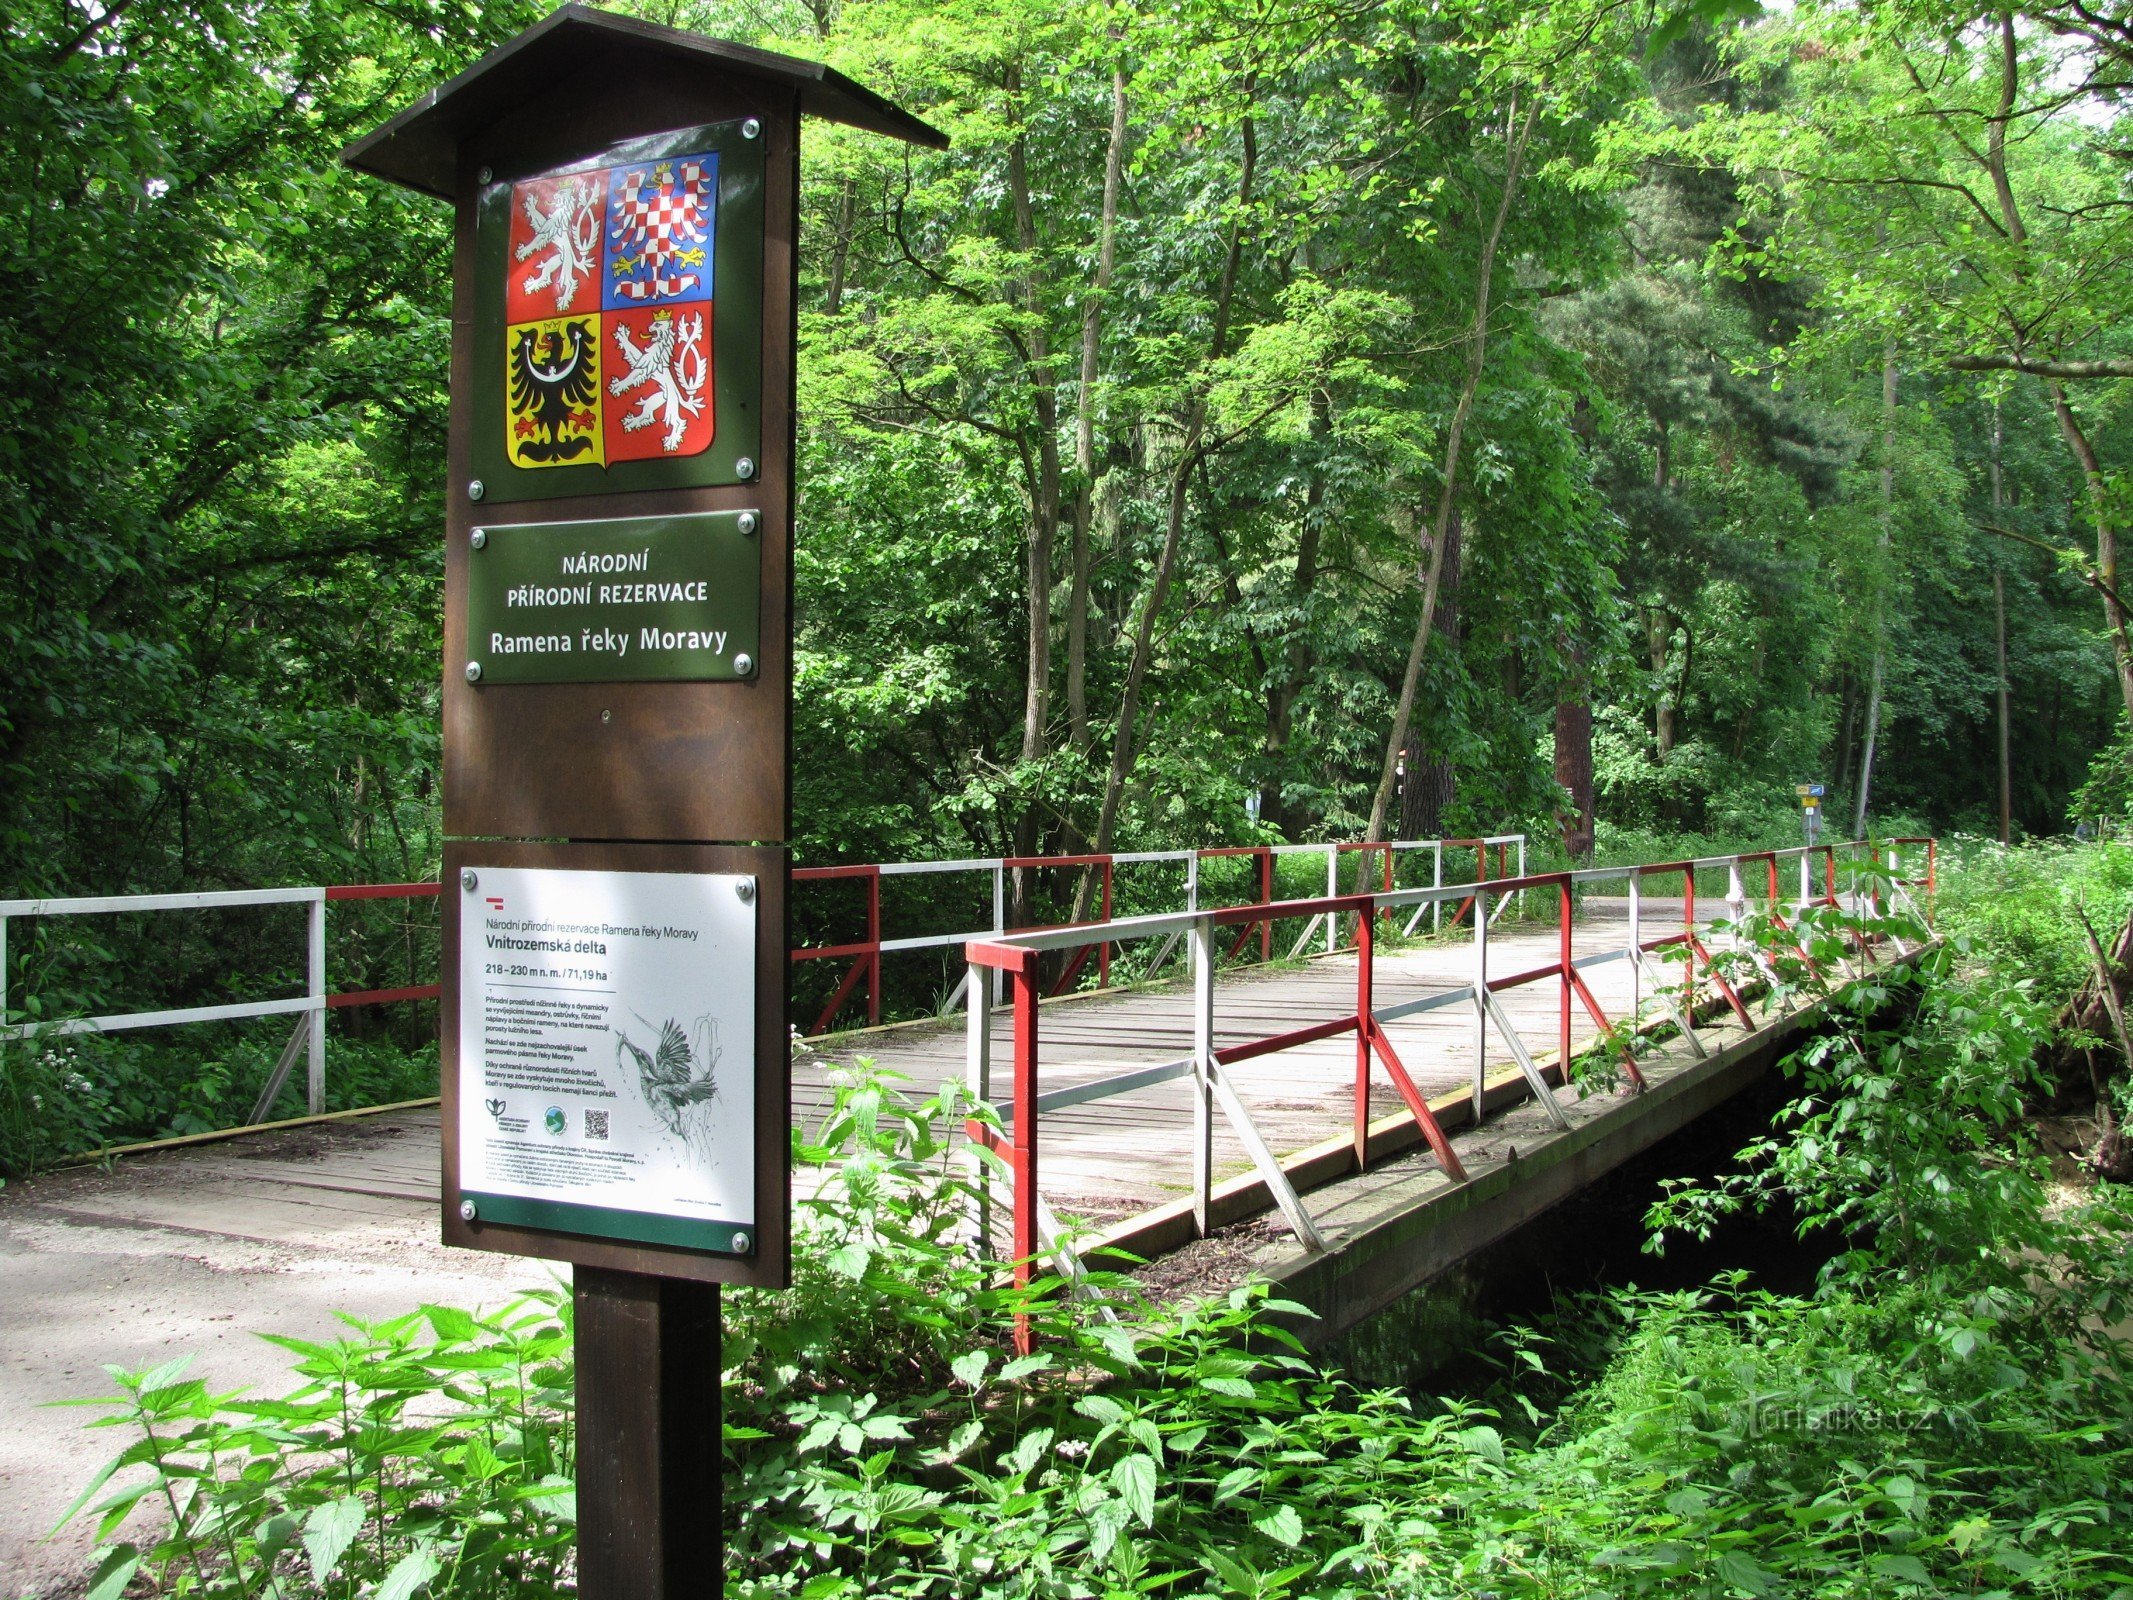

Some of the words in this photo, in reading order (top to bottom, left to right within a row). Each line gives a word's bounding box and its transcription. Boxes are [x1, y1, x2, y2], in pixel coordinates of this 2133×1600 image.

[563, 548, 650, 574] NÁRODNÍ
[508, 582, 592, 607] PŘÍRODNÍ
[600, 582, 708, 604] REZERVACE
[492, 632, 572, 654] Ramena
[582, 628, 630, 656] řeky
[640, 628, 727, 654] Moravy
[486, 918, 520, 930] Národní
[522, 919, 555, 932] přírodní
[557, 922, 599, 934] rezervace
[602, 924, 640, 936] Ramena
[642, 925, 662, 939] řeky
[664, 927, 698, 941] Moravy
[486, 934, 571, 952] Vnitrozemská
[574, 940, 606, 955] delta
[568, 969, 593, 981] 71,19
[596, 971, 607, 981] ha
